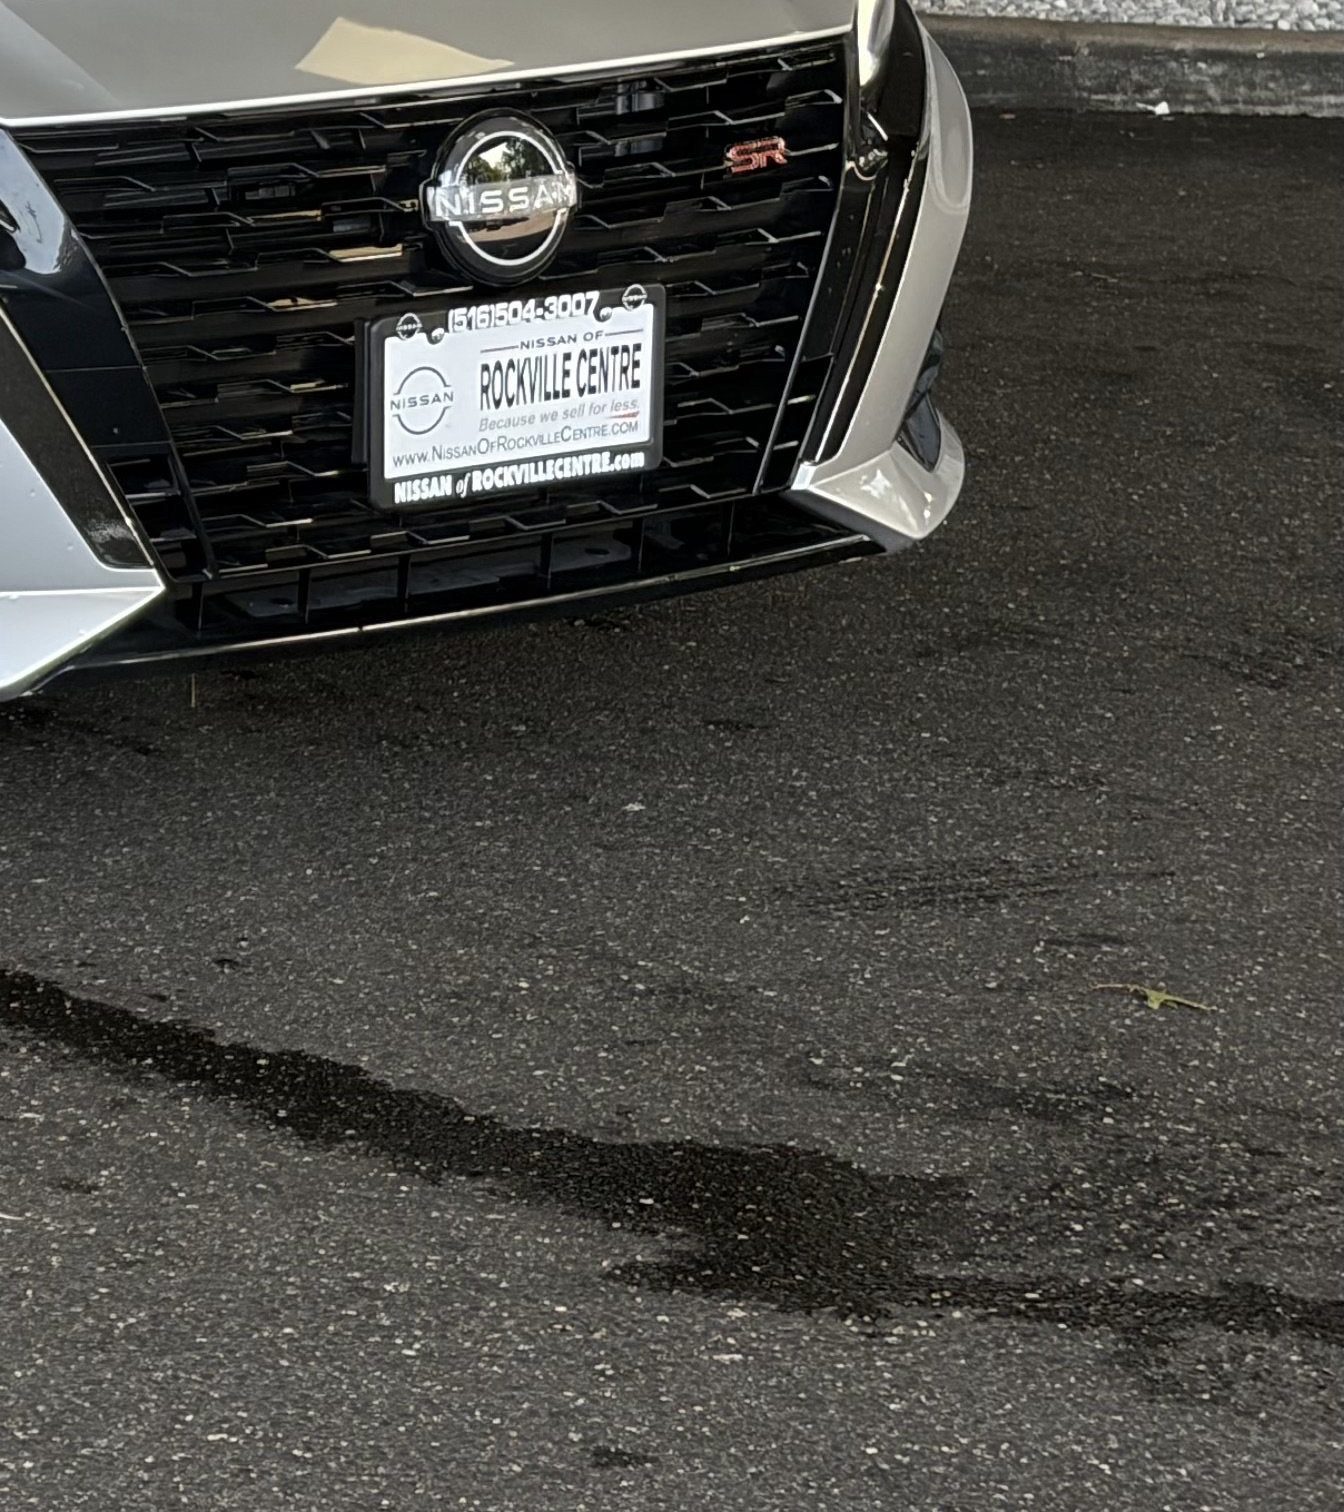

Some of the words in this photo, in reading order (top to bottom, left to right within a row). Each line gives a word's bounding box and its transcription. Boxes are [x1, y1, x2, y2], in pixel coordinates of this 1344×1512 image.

[726, 136, 788, 173] SR
[434, 178, 575, 217] NISSAN
[519, 334, 578, 351] NISSAN
[582, 330, 605, 342] OF
[479, 350, 573, 411] ROCKVILLE
[576, 342, 643, 397] CENTRE
[389, 391, 455, 411] NISSAN
[478, 414, 536, 433] Because
[539, 410, 560, 423] we
[561, 404, 585, 421] sell
[588, 402, 608, 417] for
[394, 474, 453, 504] NISSAN
[455, 471, 471, 499] of
[472, 451, 646, 492] ROCKVILLECENTRE.com
